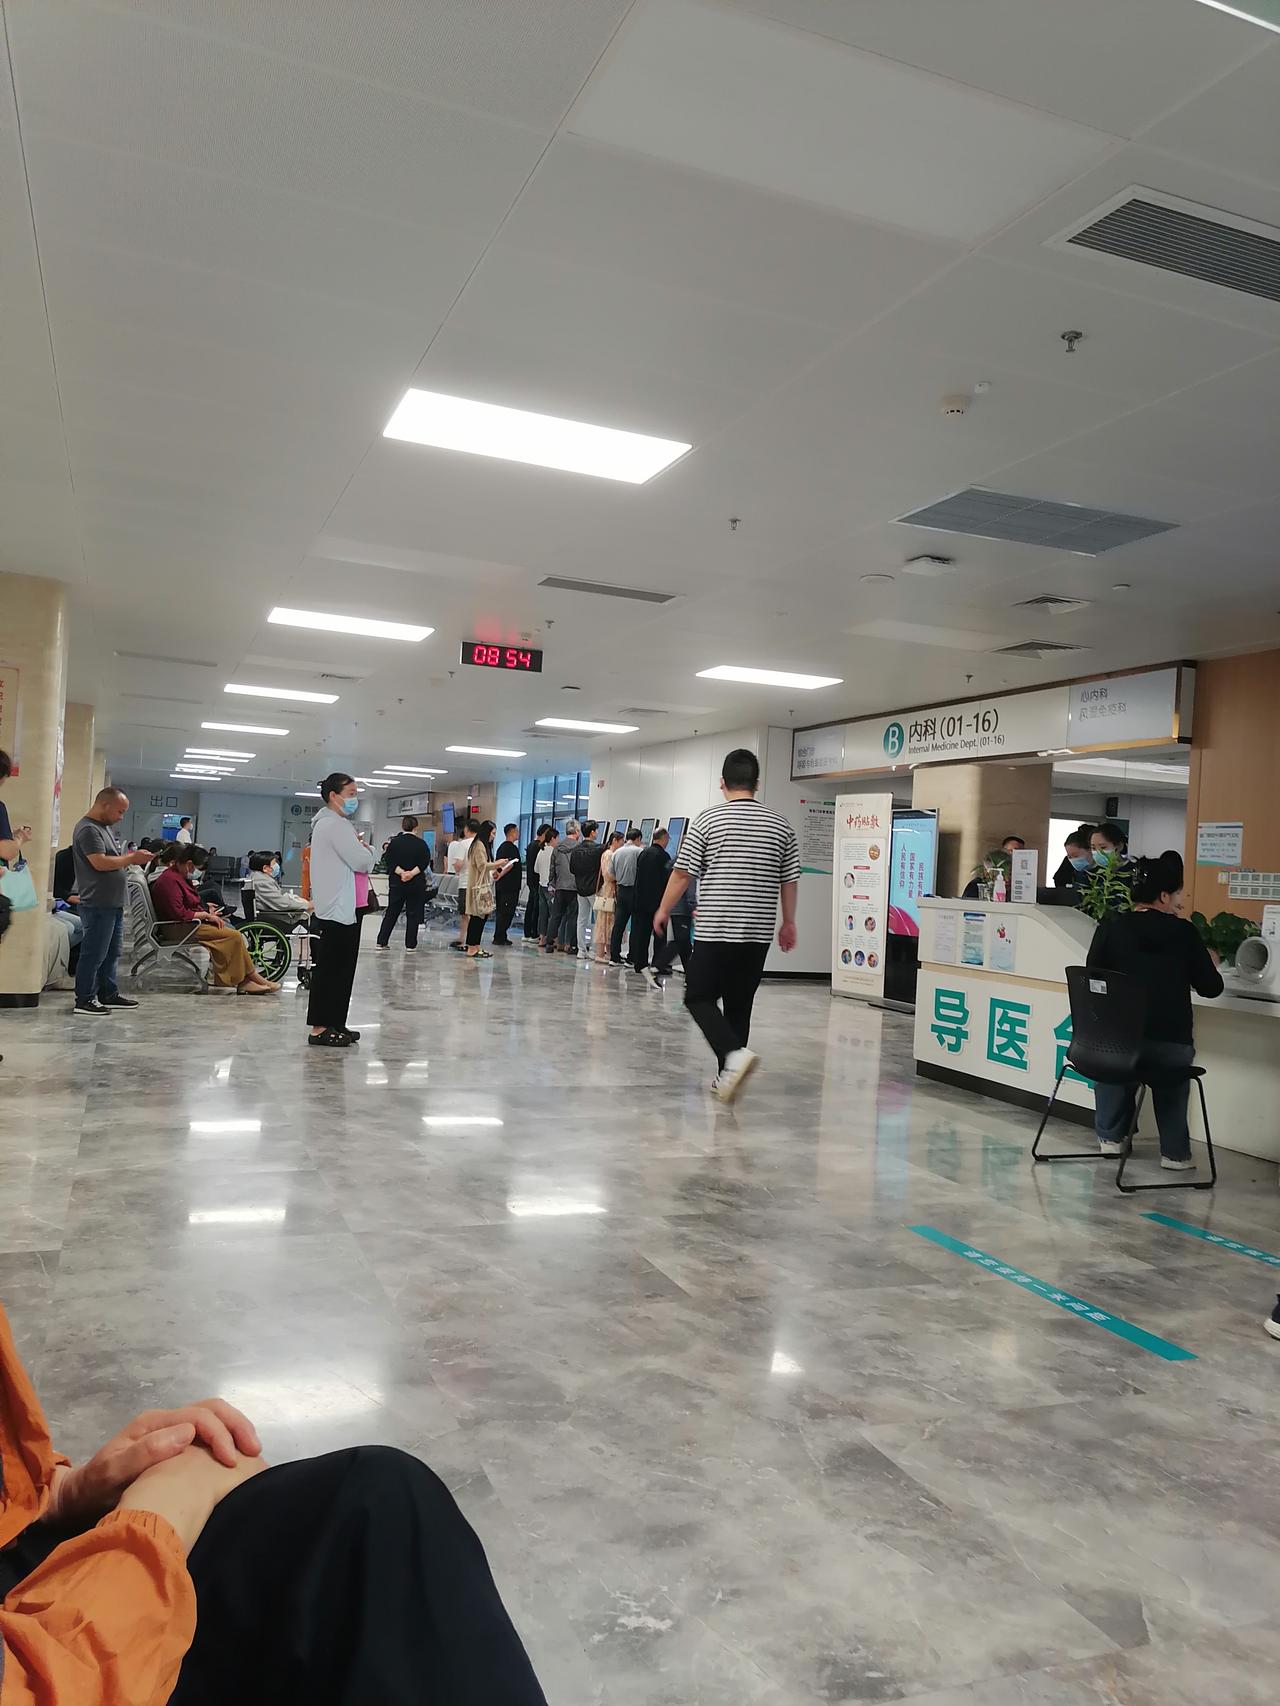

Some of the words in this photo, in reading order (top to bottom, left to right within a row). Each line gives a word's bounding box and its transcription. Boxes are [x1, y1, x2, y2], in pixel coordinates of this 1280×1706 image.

[474, 645, 500, 666] 08
[505, 648, 531, 669] 54
[888, 726, 899, 755] B
[908, 743, 930, 755] Internal
[931, 740, 959, 753] Medicine
[960, 738, 978, 751] Dept.
[979, 735, 1005, 748] (01-16)
[150, 795, 178, 808] 出口
[846, 813, 880, 830] 中药贴敷
[908, 852, 916, 899] 国家有力量
